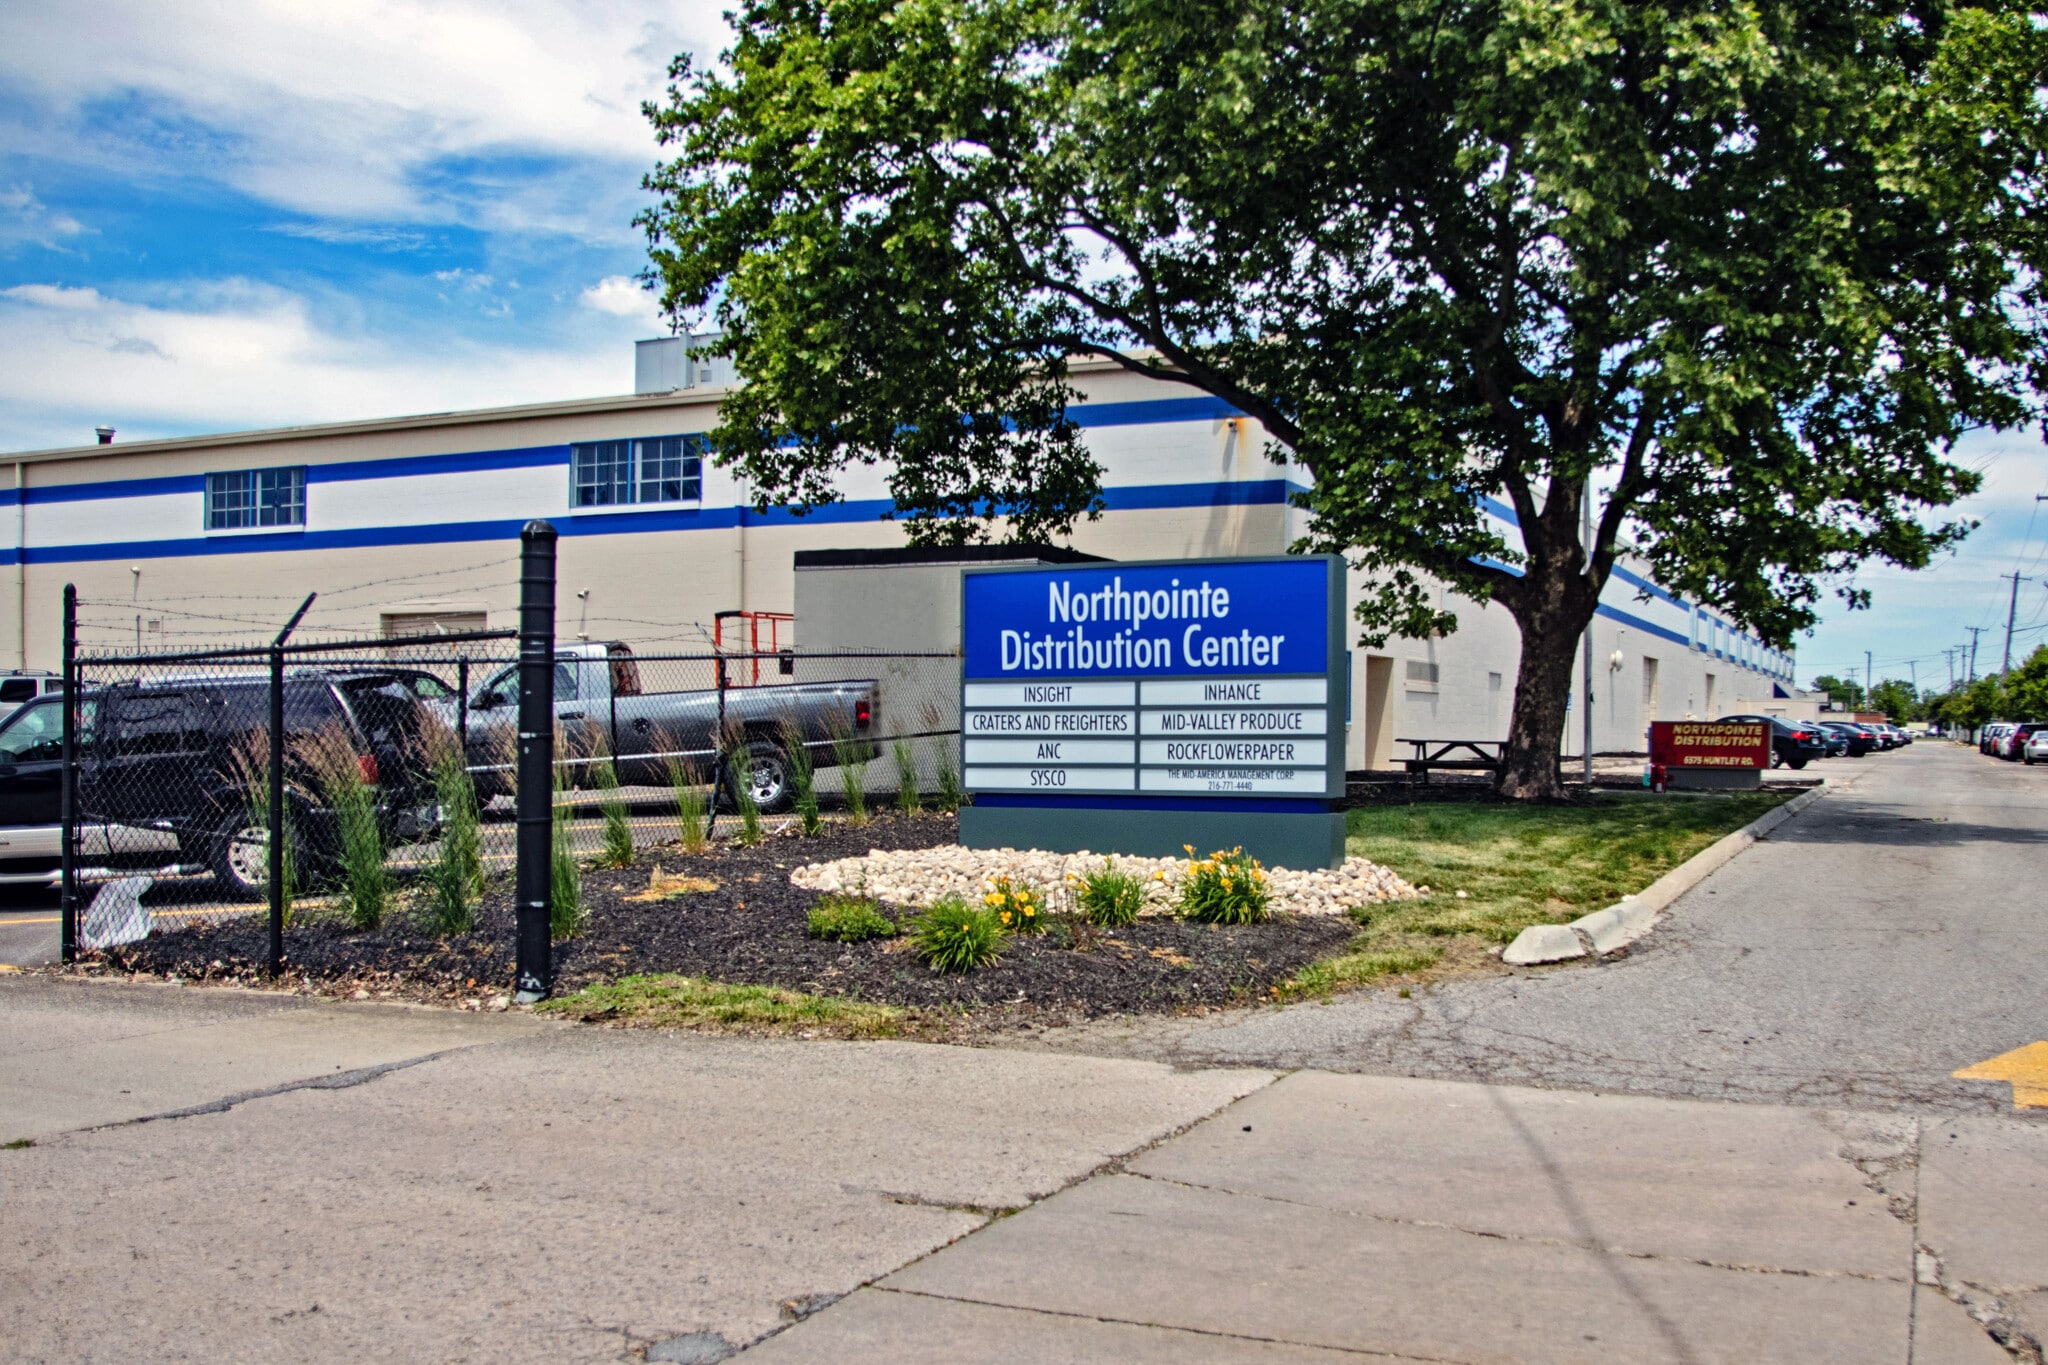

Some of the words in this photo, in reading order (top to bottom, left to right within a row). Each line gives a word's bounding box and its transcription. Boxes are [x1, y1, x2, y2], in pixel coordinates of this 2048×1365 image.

[1049, 577, 1230, 630] Northpointe
[1001, 626, 1171, 670] Distribution
[1183, 624, 1285, 667] Center
[1023, 687, 1072, 703] INSIGHT
[1204, 684, 1261, 701] INHANCE
[973, 715, 1022, 730] CRATERS
[1025, 715, 1052, 730] AND
[1055, 714, 1127, 730] FREIGHTERS
[1161, 714, 1236, 730] MID-VALLEY
[1240, 713, 1302, 730] PRODUCE
[1673, 725, 1763, 735] NORTHPOINTE
[1674, 736, 1762, 746] DISTRIBUTION
[1037, 743, 1061, 760] ANC
[1167, 744, 1294, 761] ROCKFLOWERPAPER
[1030, 770, 1066, 786] SYSCO
[1168, 770, 1180, 779] THE
[1182, 769, 1226, 780] MID-AMERICA
[1227, 770, 1274, 780] MANAGEMENT
